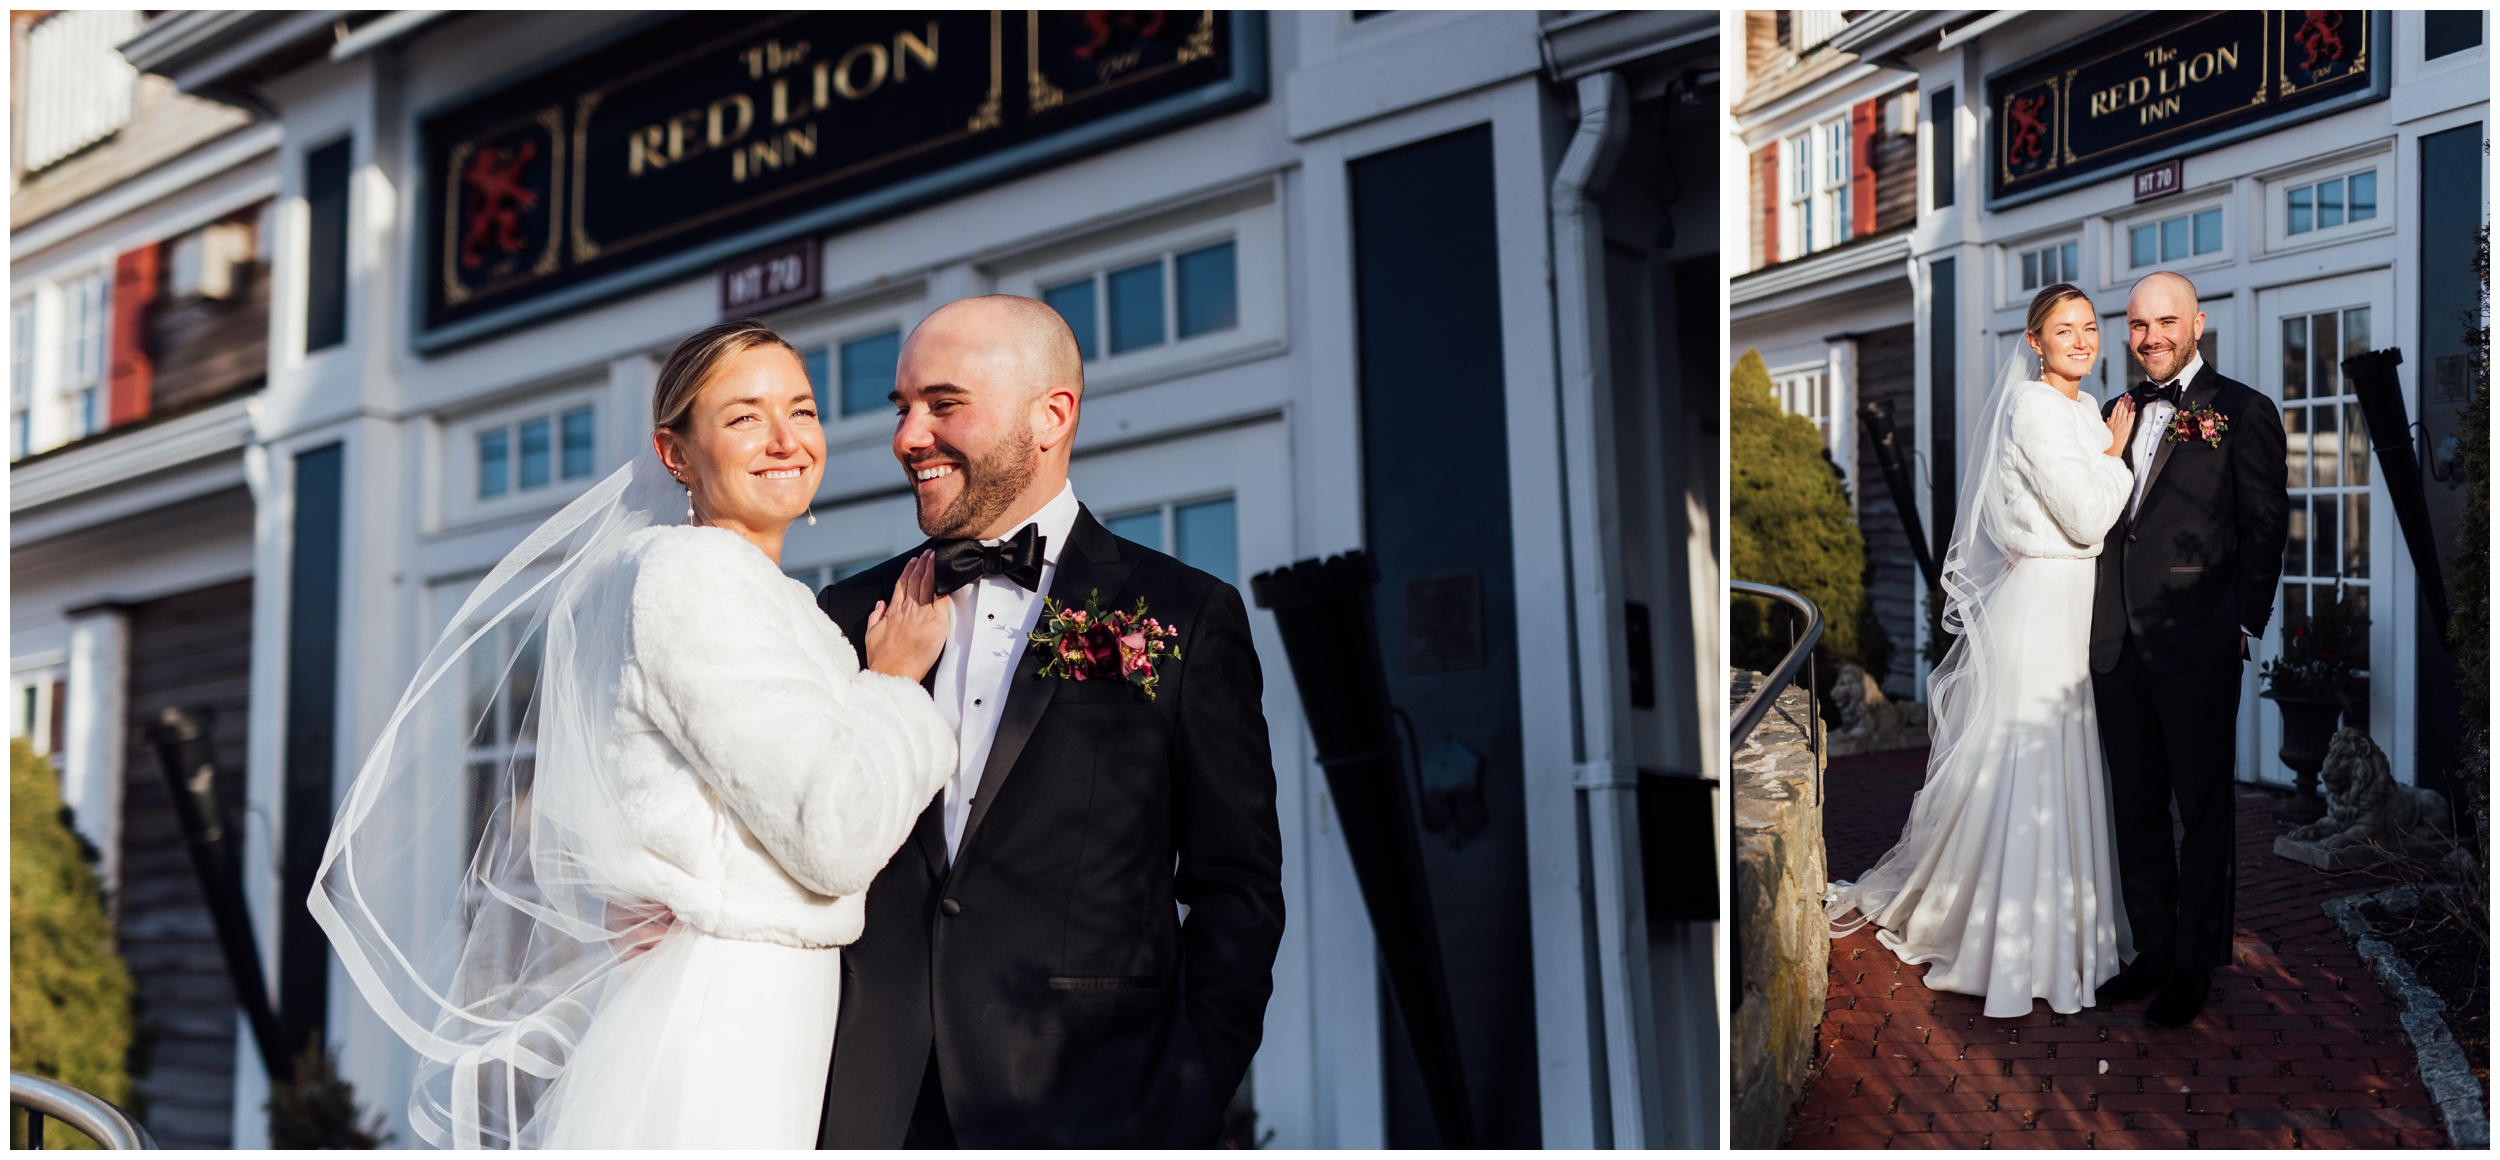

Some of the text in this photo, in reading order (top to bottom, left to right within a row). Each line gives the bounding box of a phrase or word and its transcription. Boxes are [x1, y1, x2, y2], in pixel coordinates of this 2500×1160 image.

[739, 38, 811, 80] The
[2144, 45, 2178, 68] The
[629, 20, 939, 176] RED LION
[2091, 41, 2239, 119] RED LION
[2140, 94, 2180, 126] INN
[732, 122, 817, 182] INN
[2138, 168, 2172, 193] HT 70
[766, 254, 802, 295] 70
